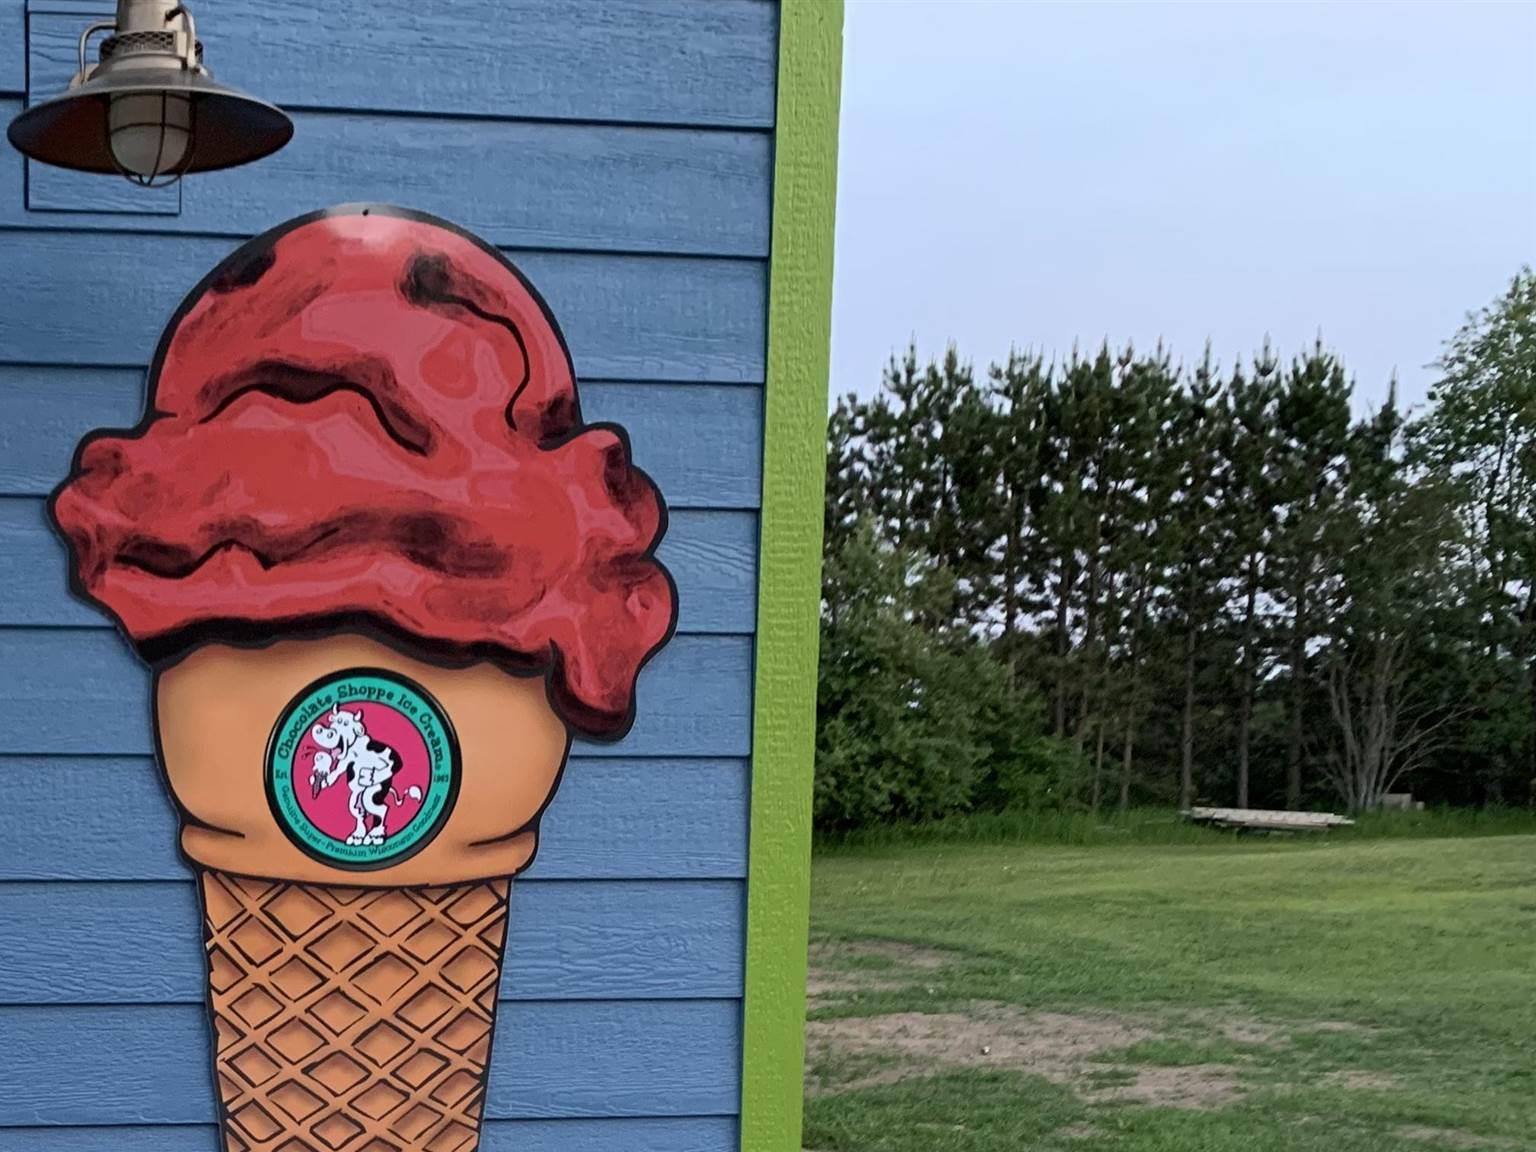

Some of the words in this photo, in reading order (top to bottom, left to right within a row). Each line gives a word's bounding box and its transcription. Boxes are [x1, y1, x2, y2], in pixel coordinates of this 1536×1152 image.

[278, 694, 332, 760] Chocolate
[336, 683, 395, 701] Shoppe
[398, 693, 418, 715] Ice
